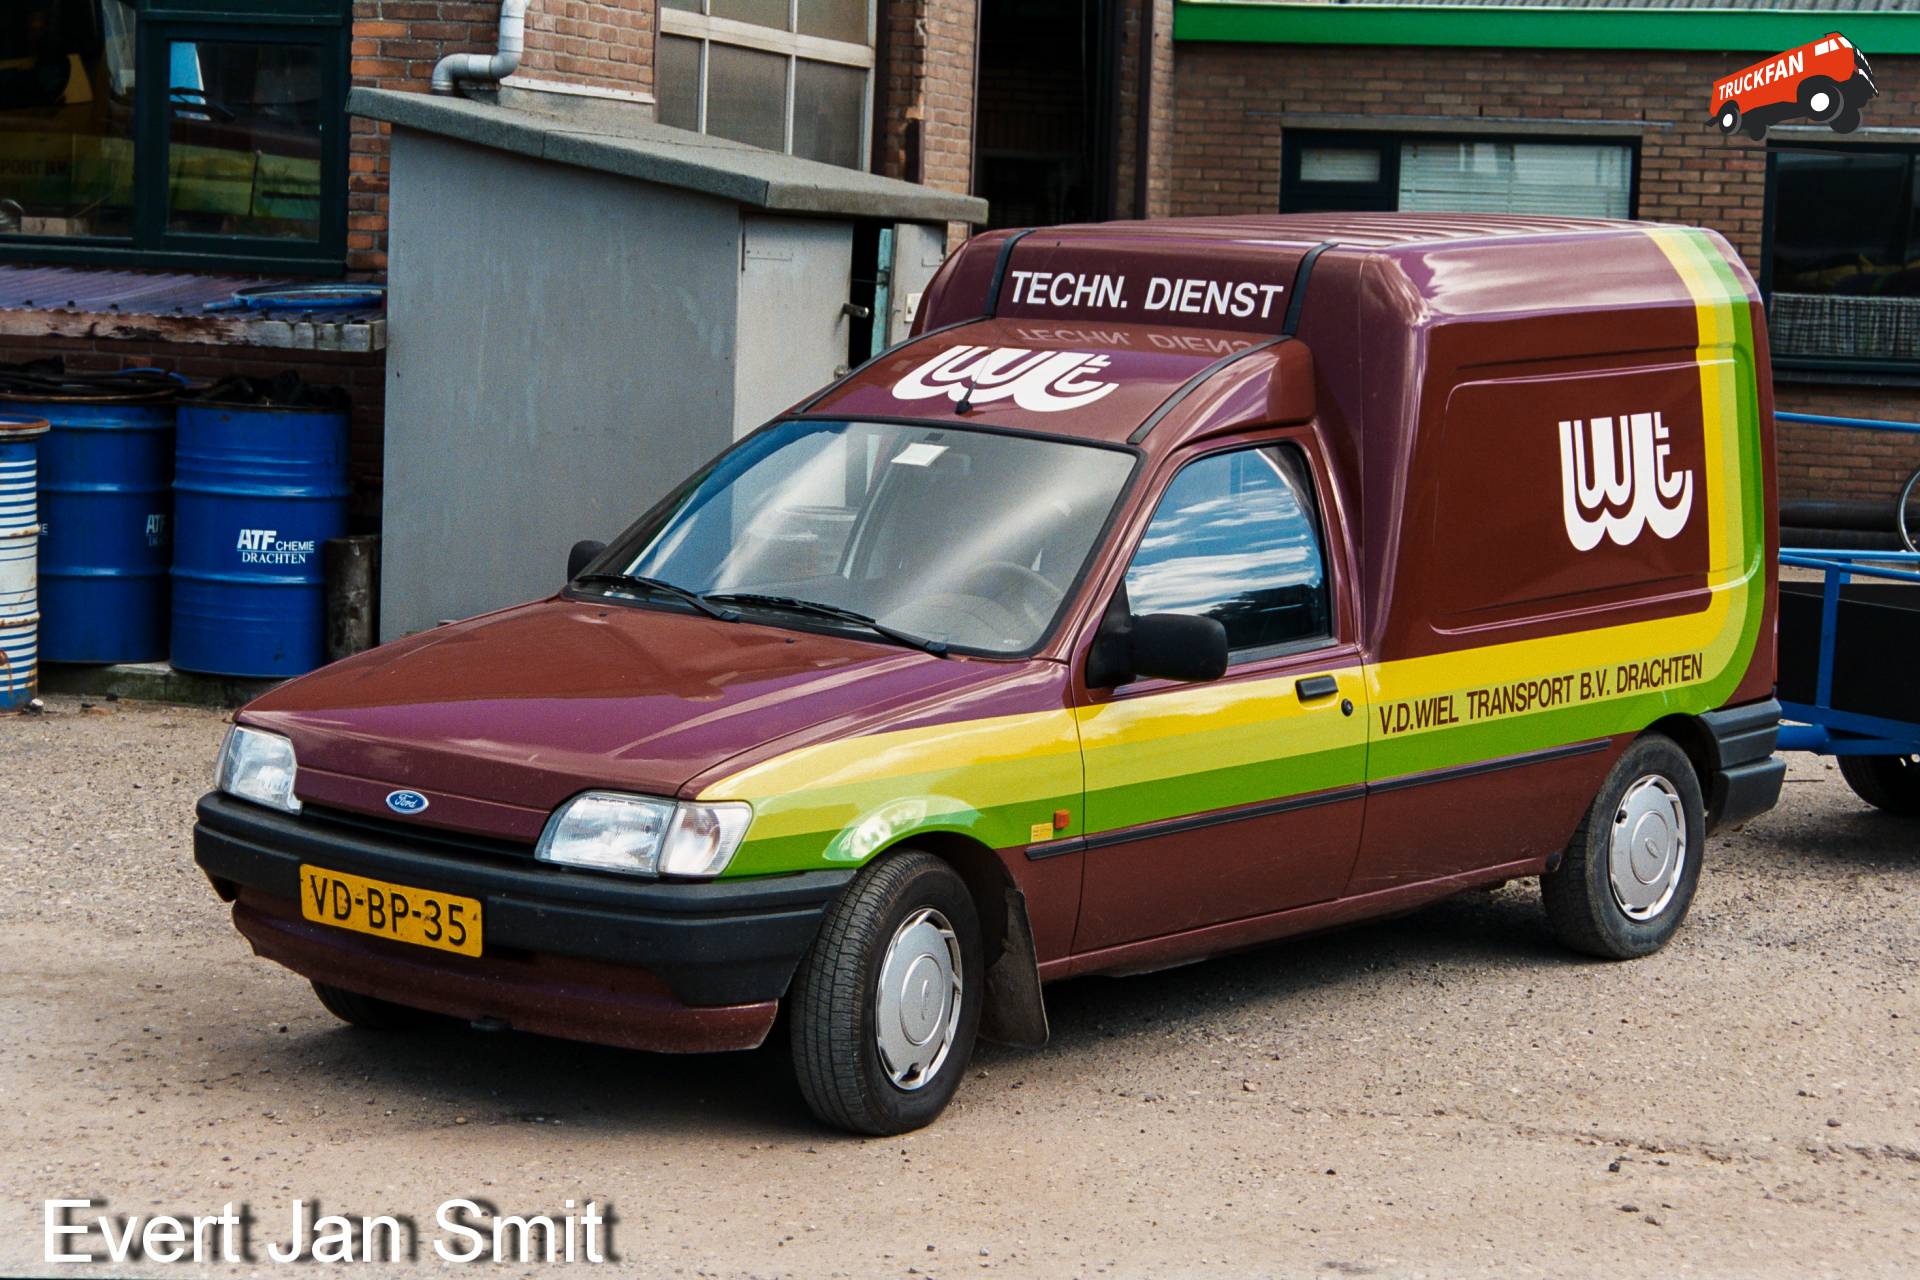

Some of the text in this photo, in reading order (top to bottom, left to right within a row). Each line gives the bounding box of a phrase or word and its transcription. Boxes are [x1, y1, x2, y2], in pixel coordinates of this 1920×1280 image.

[1011, 271, 1284, 318] TECHN. DIENST
[237, 529, 315, 552] ATF CHEMIE
[242, 551, 306, 564] DRACHTEN
[1466, 674, 1574, 720] TRANSPORT
[1579, 668, 1610, 701] B.V.
[1616, 652, 1703, 693] DRACHTEN
[310, 874, 467, 947] VD-BP-35
